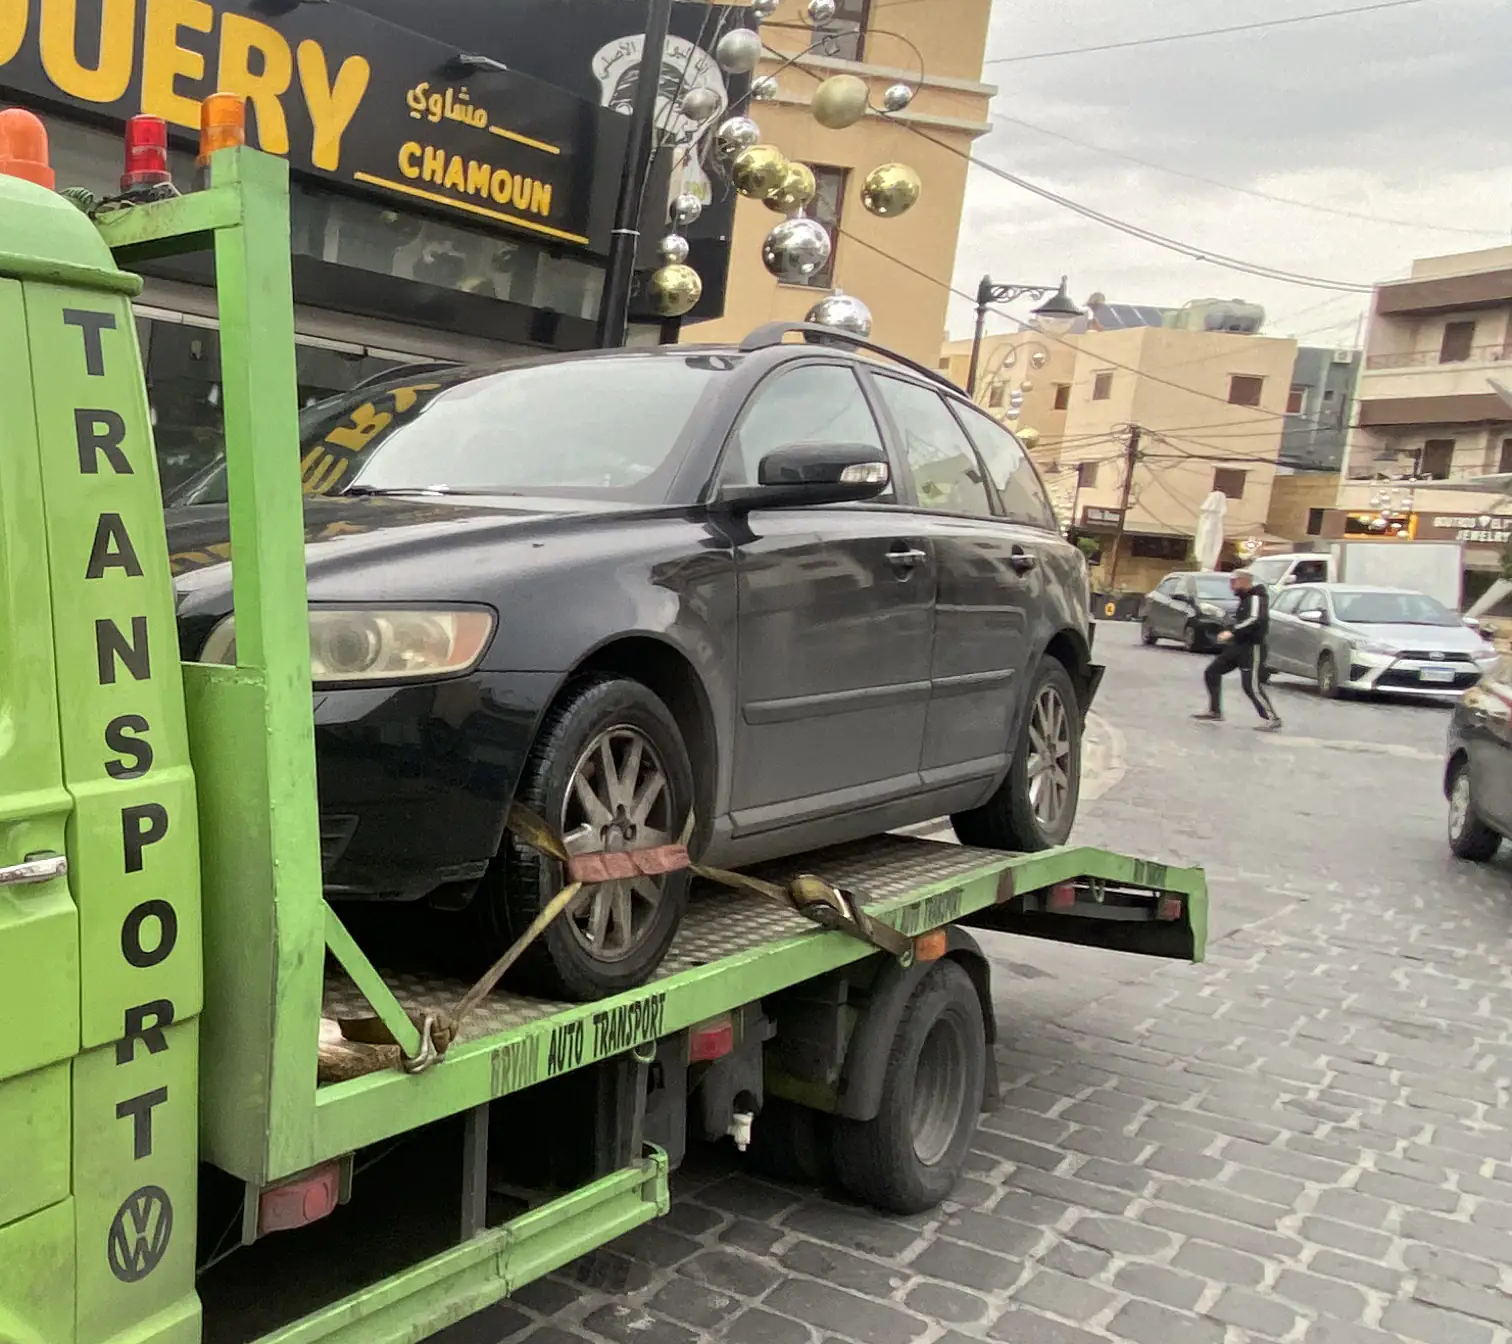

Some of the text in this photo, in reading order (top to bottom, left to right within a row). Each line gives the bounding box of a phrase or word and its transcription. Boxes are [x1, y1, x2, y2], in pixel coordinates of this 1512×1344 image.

[406, 81, 488, 129] مشاوي
[398, 141, 552, 216] CHAMOUN
[63, 308, 178, 1160] TRANSPORT
[548, 1019, 584, 1076] AUTO
[593, 992, 666, 1058] TRANSPORT
